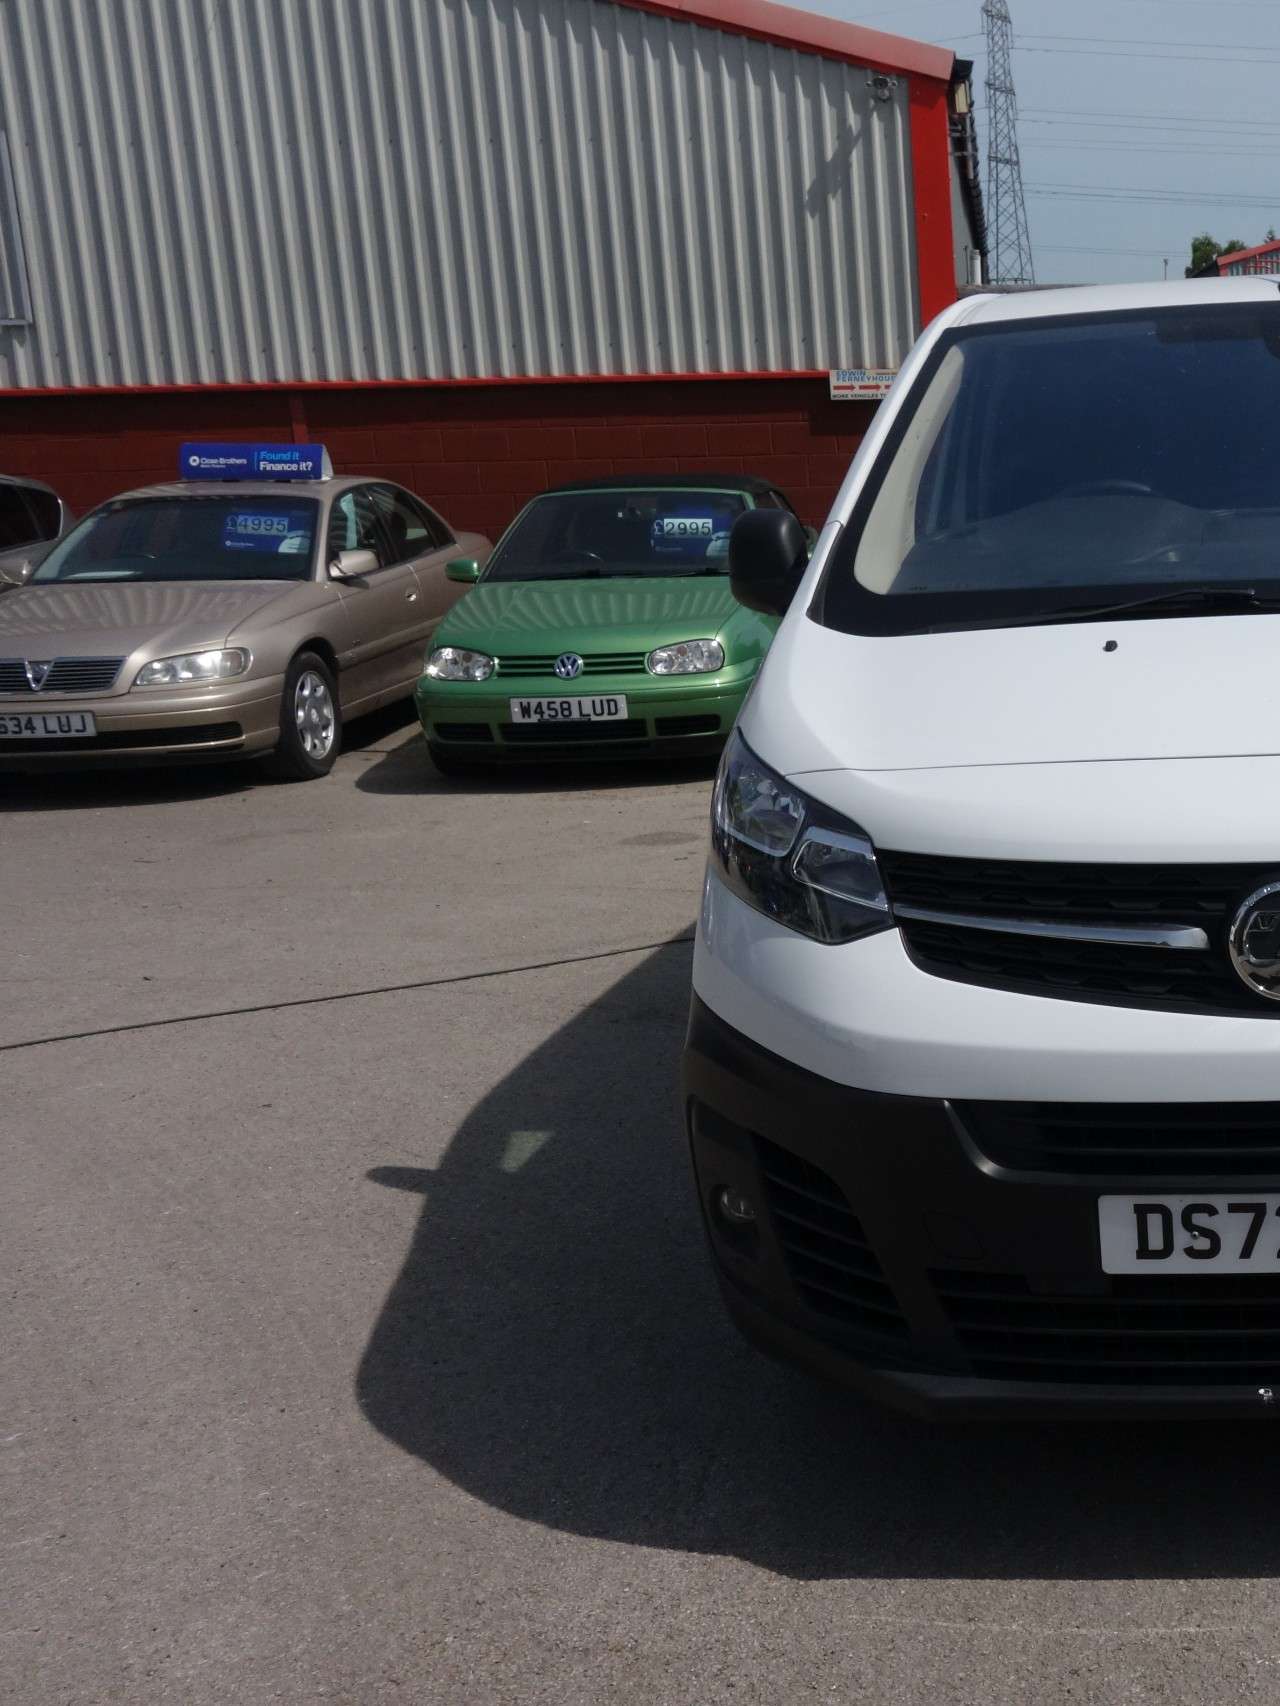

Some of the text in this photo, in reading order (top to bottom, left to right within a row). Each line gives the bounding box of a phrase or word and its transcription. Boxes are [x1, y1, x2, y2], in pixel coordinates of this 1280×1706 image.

[260, 451, 290, 461] Found
[259, 461, 298, 471] Finance
[519, 698, 619, 719] W458 LUD
[42, 714, 87, 734] LUJ
